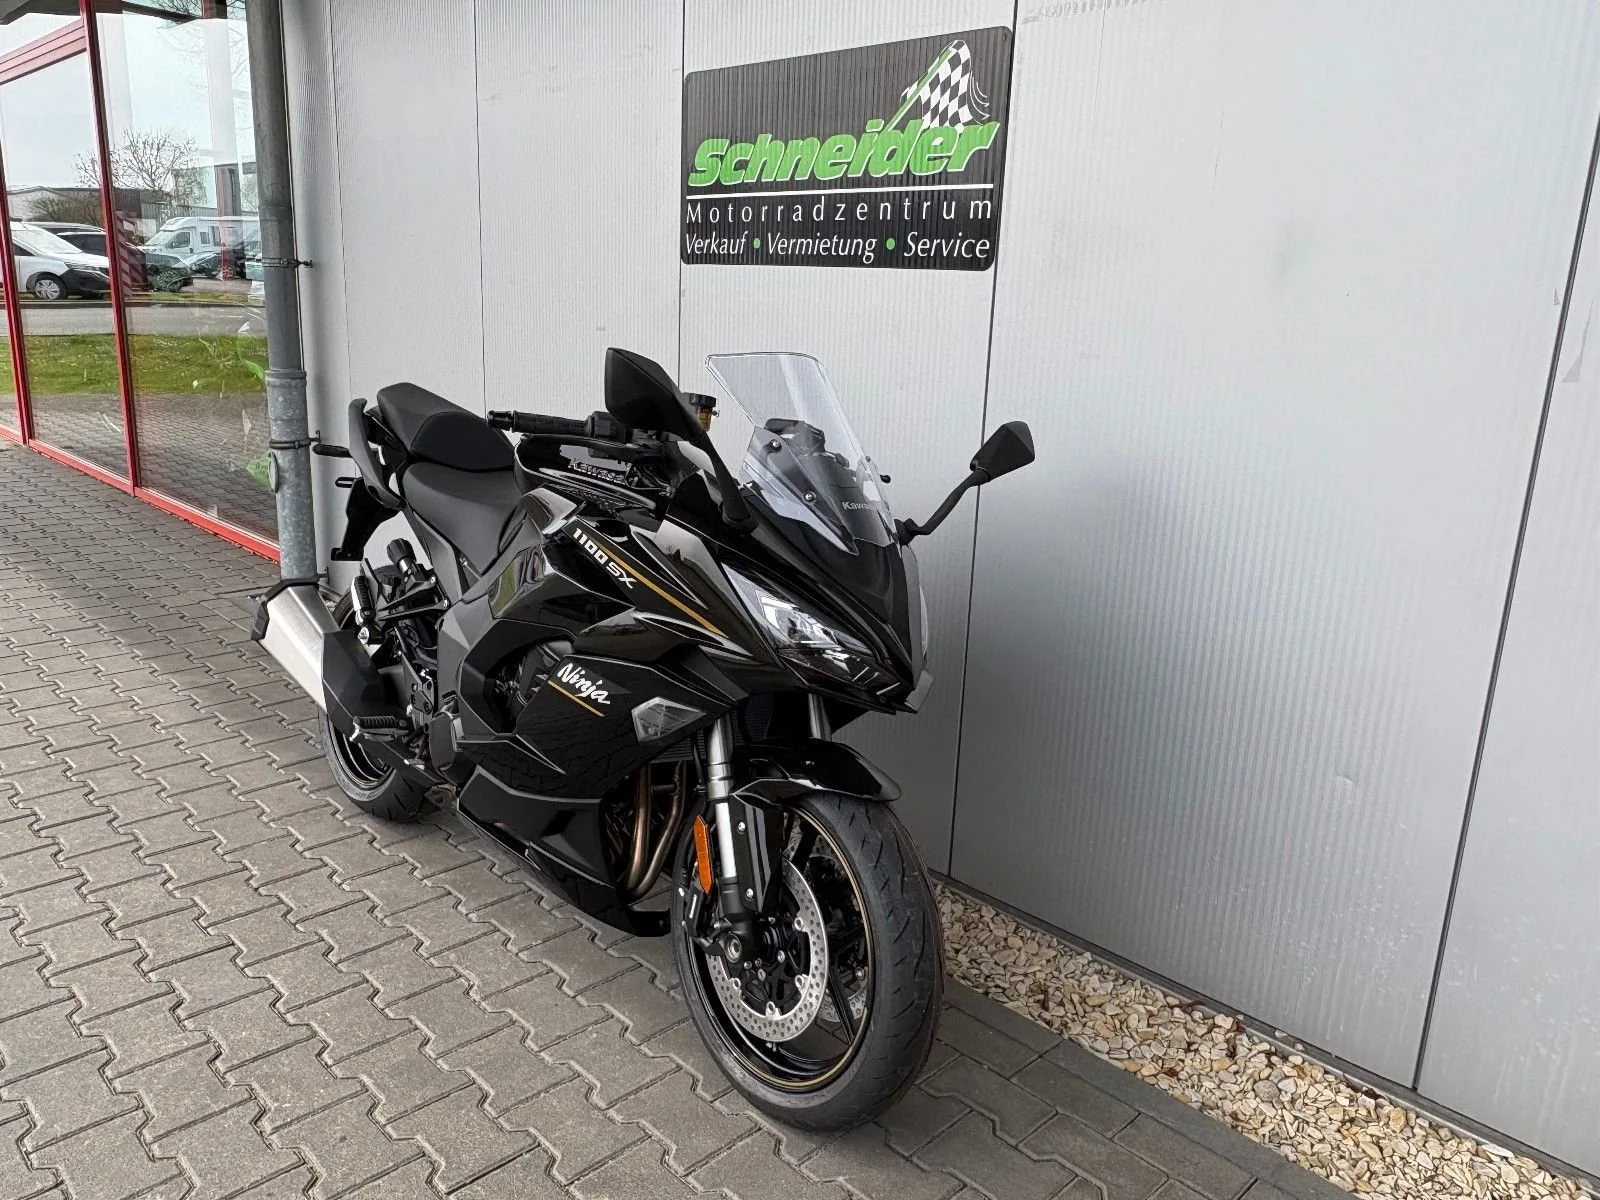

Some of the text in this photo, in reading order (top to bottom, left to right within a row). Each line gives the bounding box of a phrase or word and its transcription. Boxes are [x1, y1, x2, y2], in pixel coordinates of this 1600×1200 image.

[686, 196, 991, 223] Motorradzentrum
[686, 231, 990, 263] Verkauf Vermietung Service
[573, 528, 638, 589] 1100 SX
[557, 663, 611, 704] Ninja
